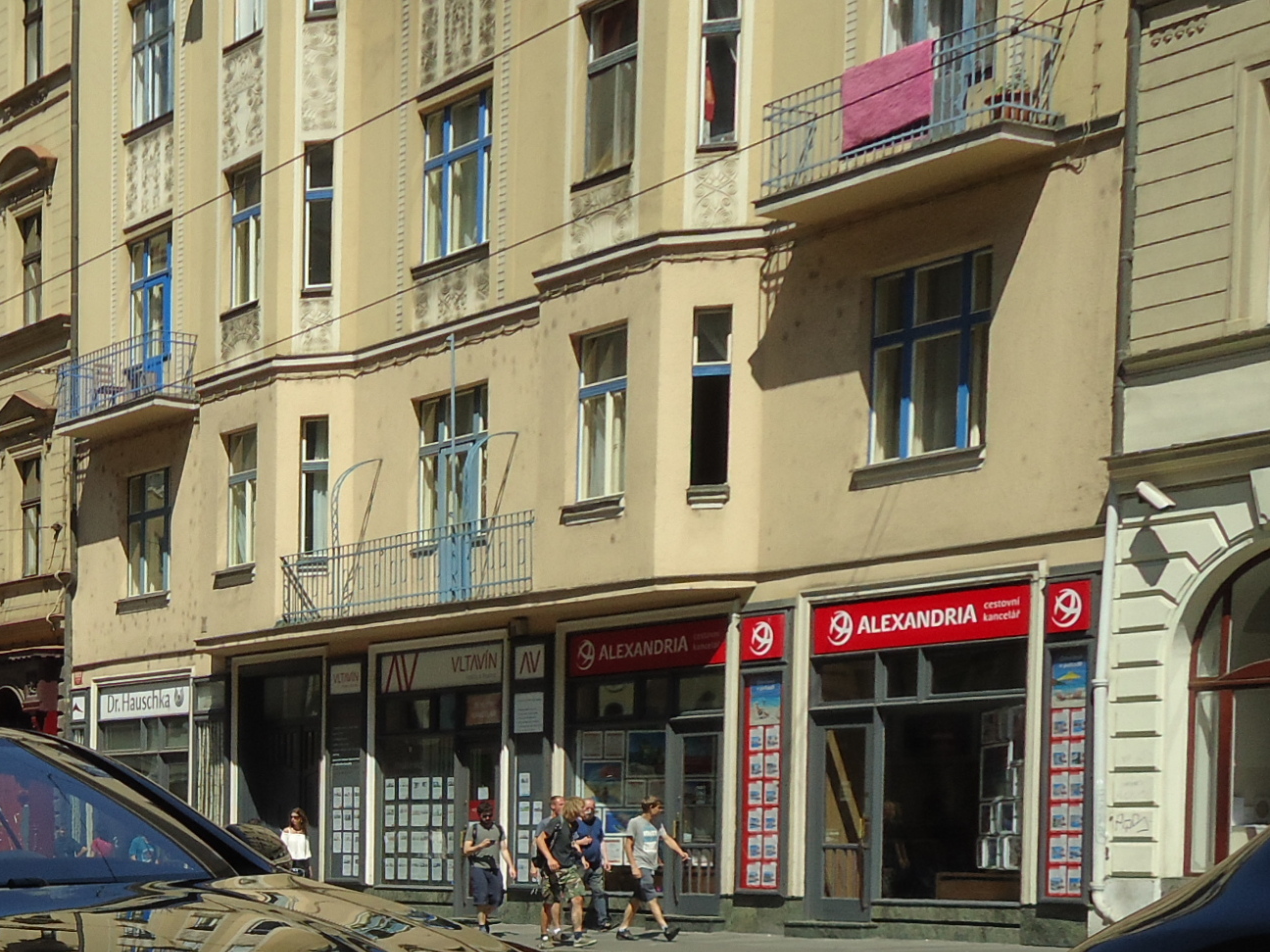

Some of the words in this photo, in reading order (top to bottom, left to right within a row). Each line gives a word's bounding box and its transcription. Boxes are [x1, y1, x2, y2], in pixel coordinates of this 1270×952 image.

[857, 604, 978, 635] ALEXANDRIA
[983, 596, 1021, 610] cestovní
[983, 609, 1021, 622] kancelář
[598, 635, 689, 660] ALEXANDRIA
[451, 649, 498, 673] VLTAVÍN
[107, 694, 121, 714] Dr.
[122, 689, 171, 713] Hauschka
